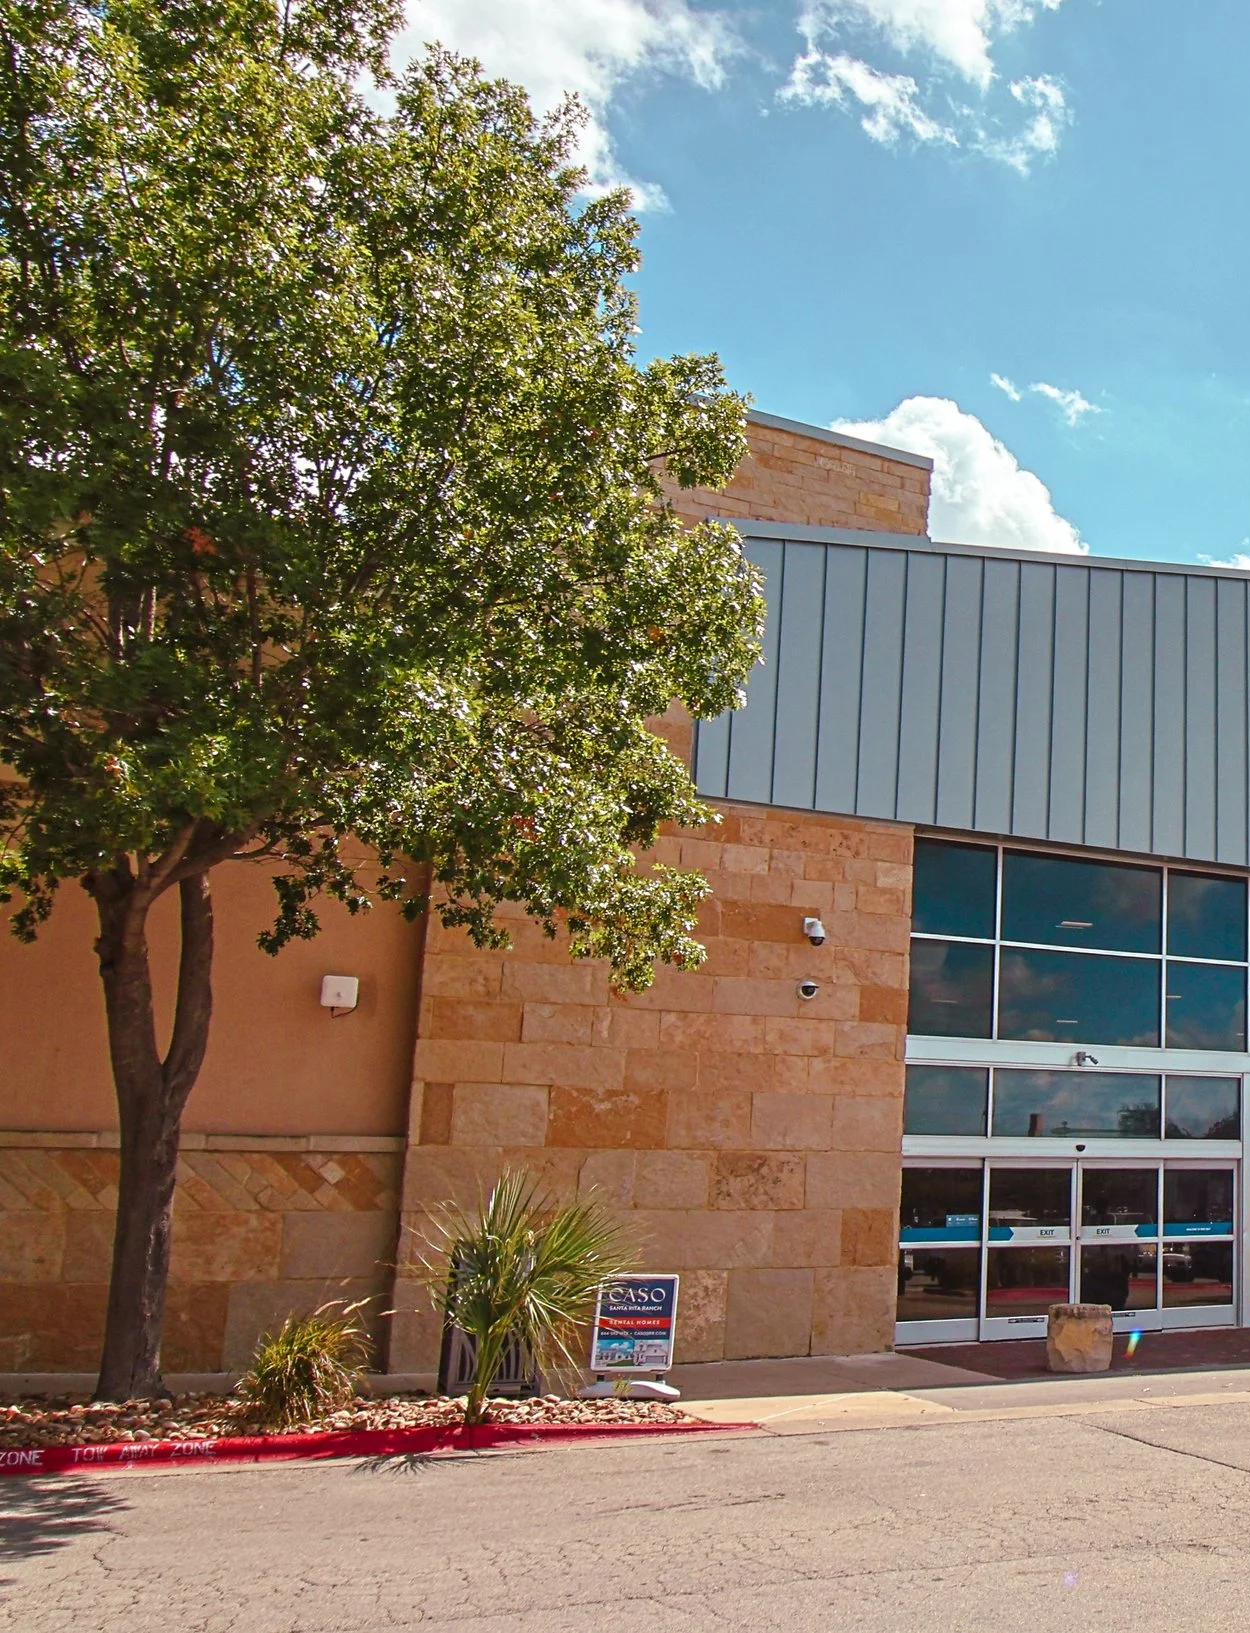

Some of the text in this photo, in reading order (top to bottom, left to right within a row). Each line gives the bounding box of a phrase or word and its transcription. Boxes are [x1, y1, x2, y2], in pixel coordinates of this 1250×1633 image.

[609, 1287, 666, 1303] CASO
[0, 1440, 217, 1467] ZONE TOW AWAY ZONE
